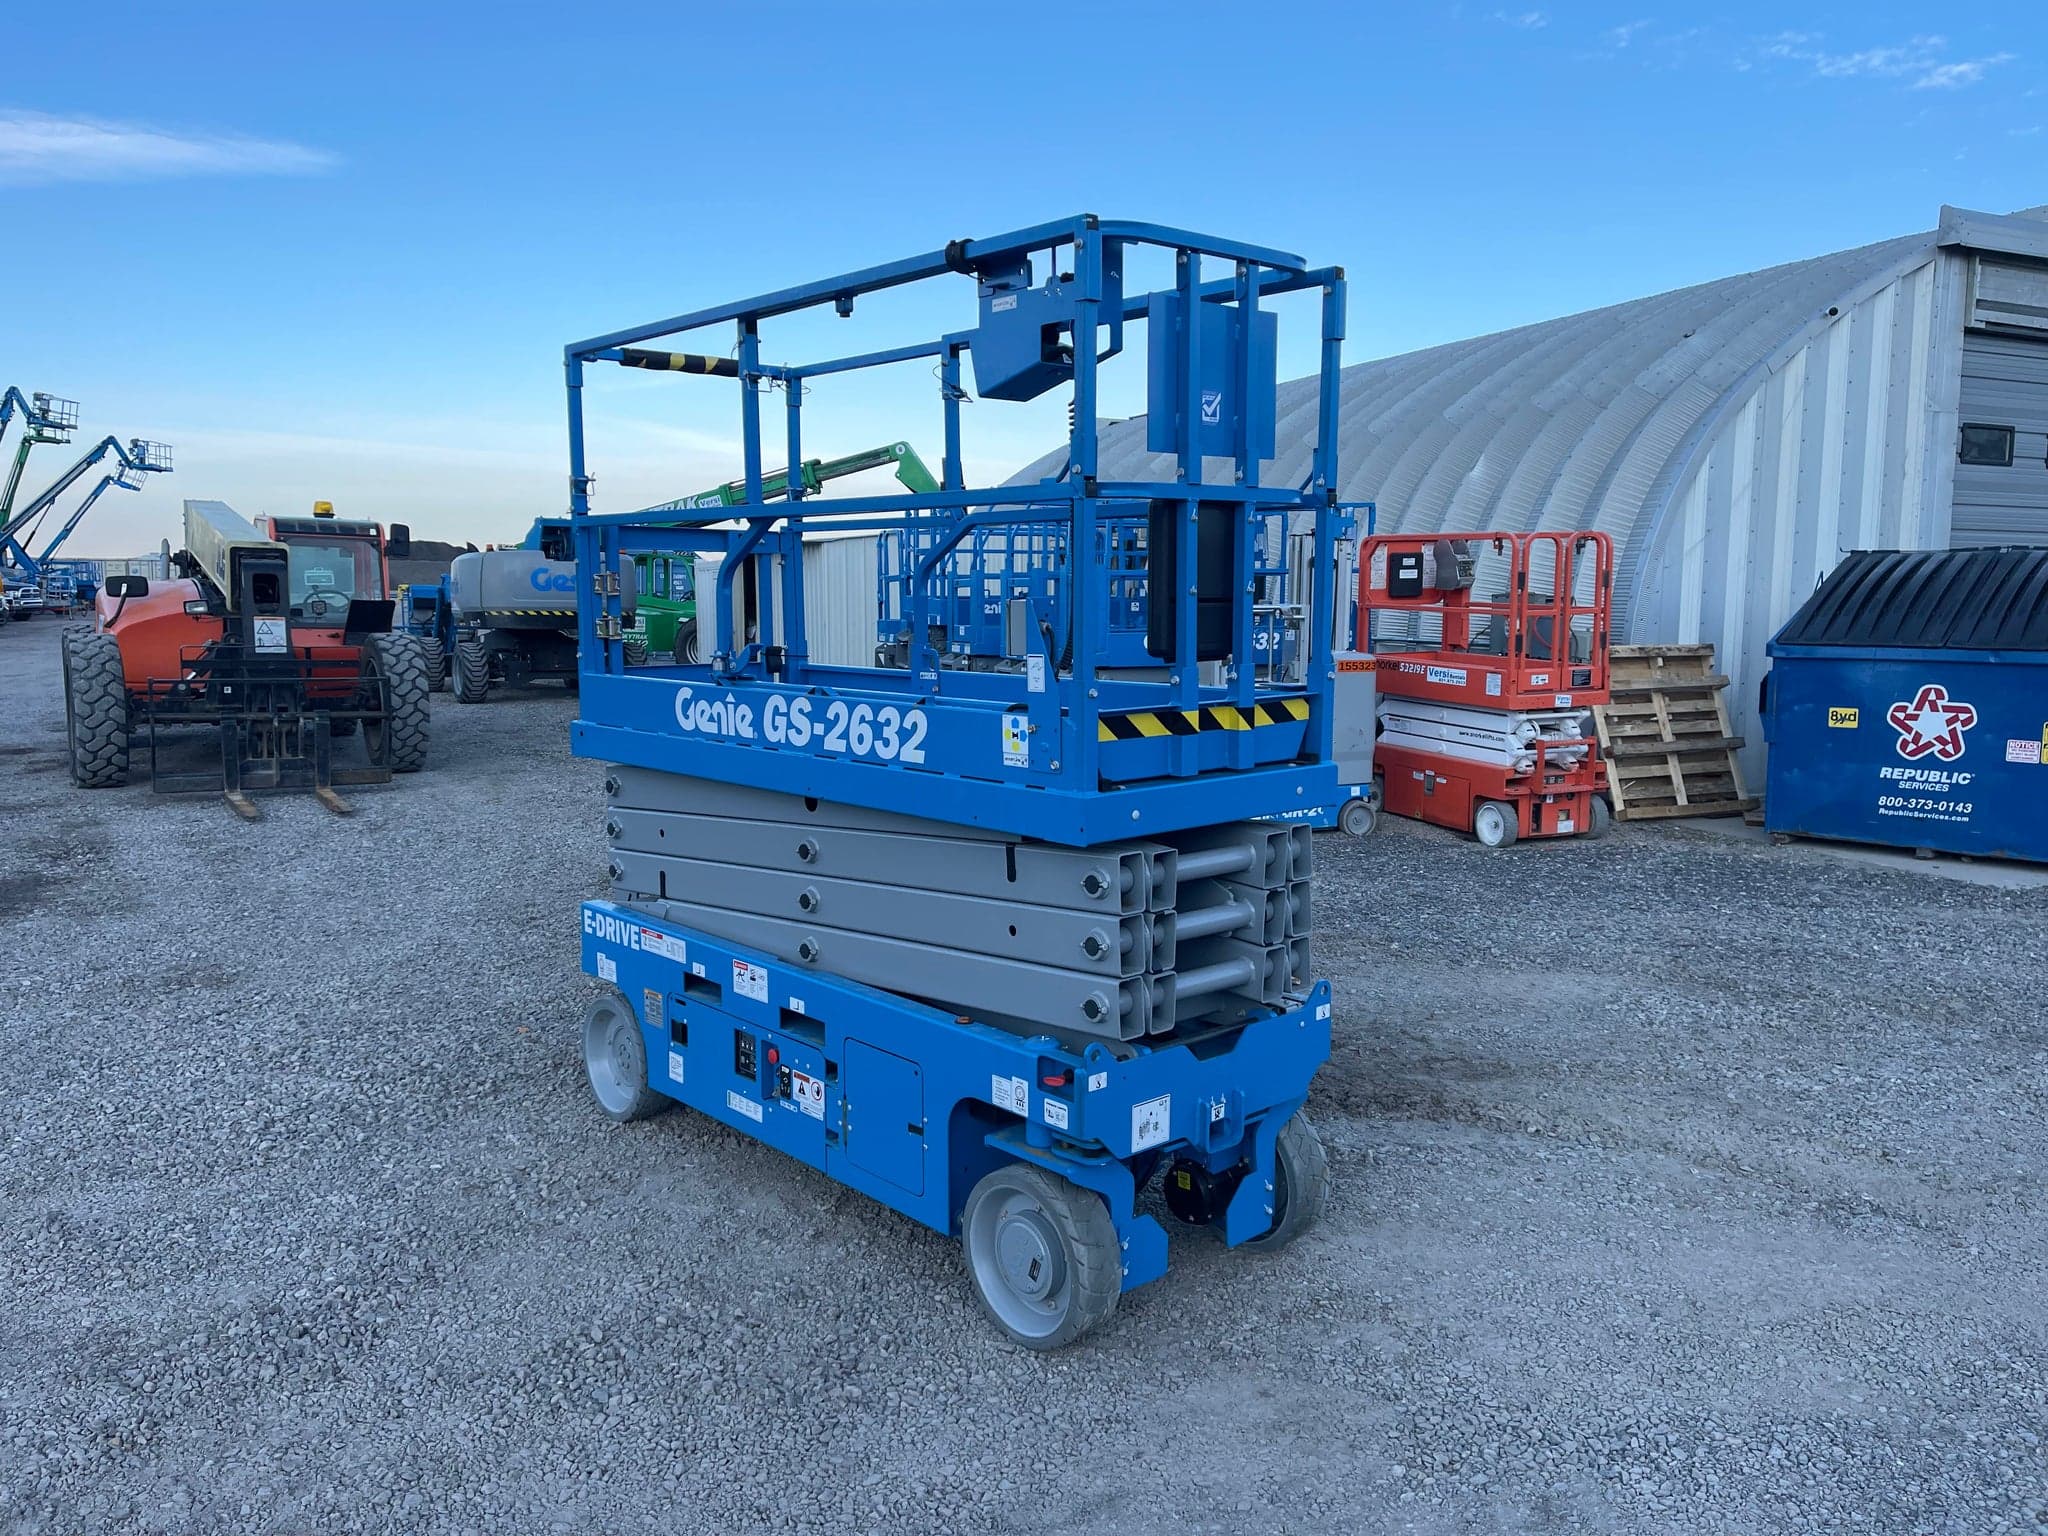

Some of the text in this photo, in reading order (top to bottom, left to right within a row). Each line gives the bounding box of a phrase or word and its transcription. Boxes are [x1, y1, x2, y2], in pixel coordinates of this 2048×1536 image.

[530, 567, 576, 592] Ge
[1253, 632, 1281, 650] 32
[1339, 661, 1376, 671] 155323
[1428, 667, 1450, 678] Versi
[675, 686, 928, 764] Genie GS-2632
[1880, 767, 1972, 785] REPUBLIC
[1898, 781, 1950, 792] SERVICES
[1878, 796, 1973, 814] 800-373-0143
[1879, 808, 1970, 822] RepublicServices.com
[584, 909, 640, 951] E-DRIVE
